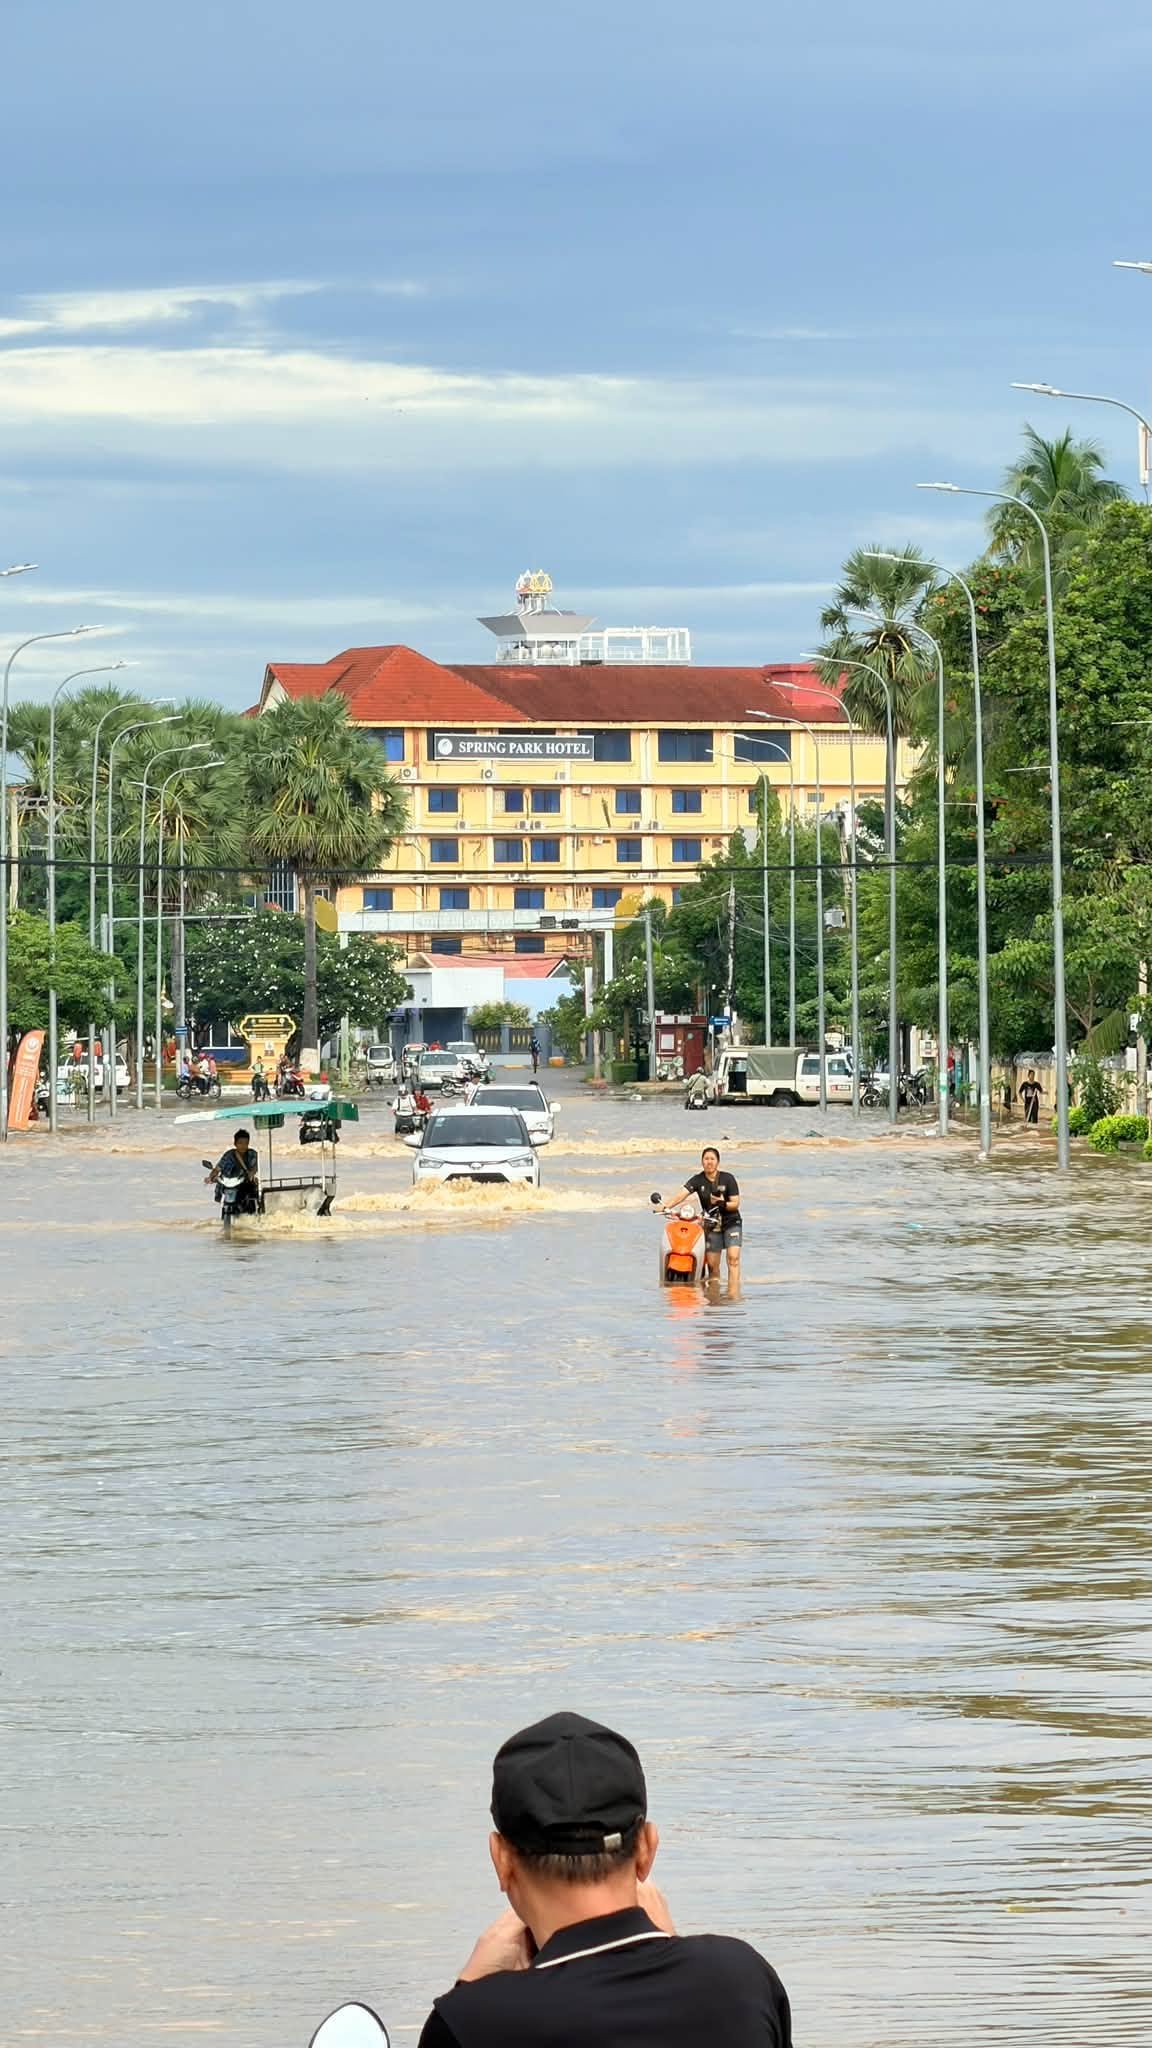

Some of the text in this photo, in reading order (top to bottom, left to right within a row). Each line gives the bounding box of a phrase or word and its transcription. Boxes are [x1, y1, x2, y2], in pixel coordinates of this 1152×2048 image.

[459, 741, 590, 755] SPRING PARK HOTEL
